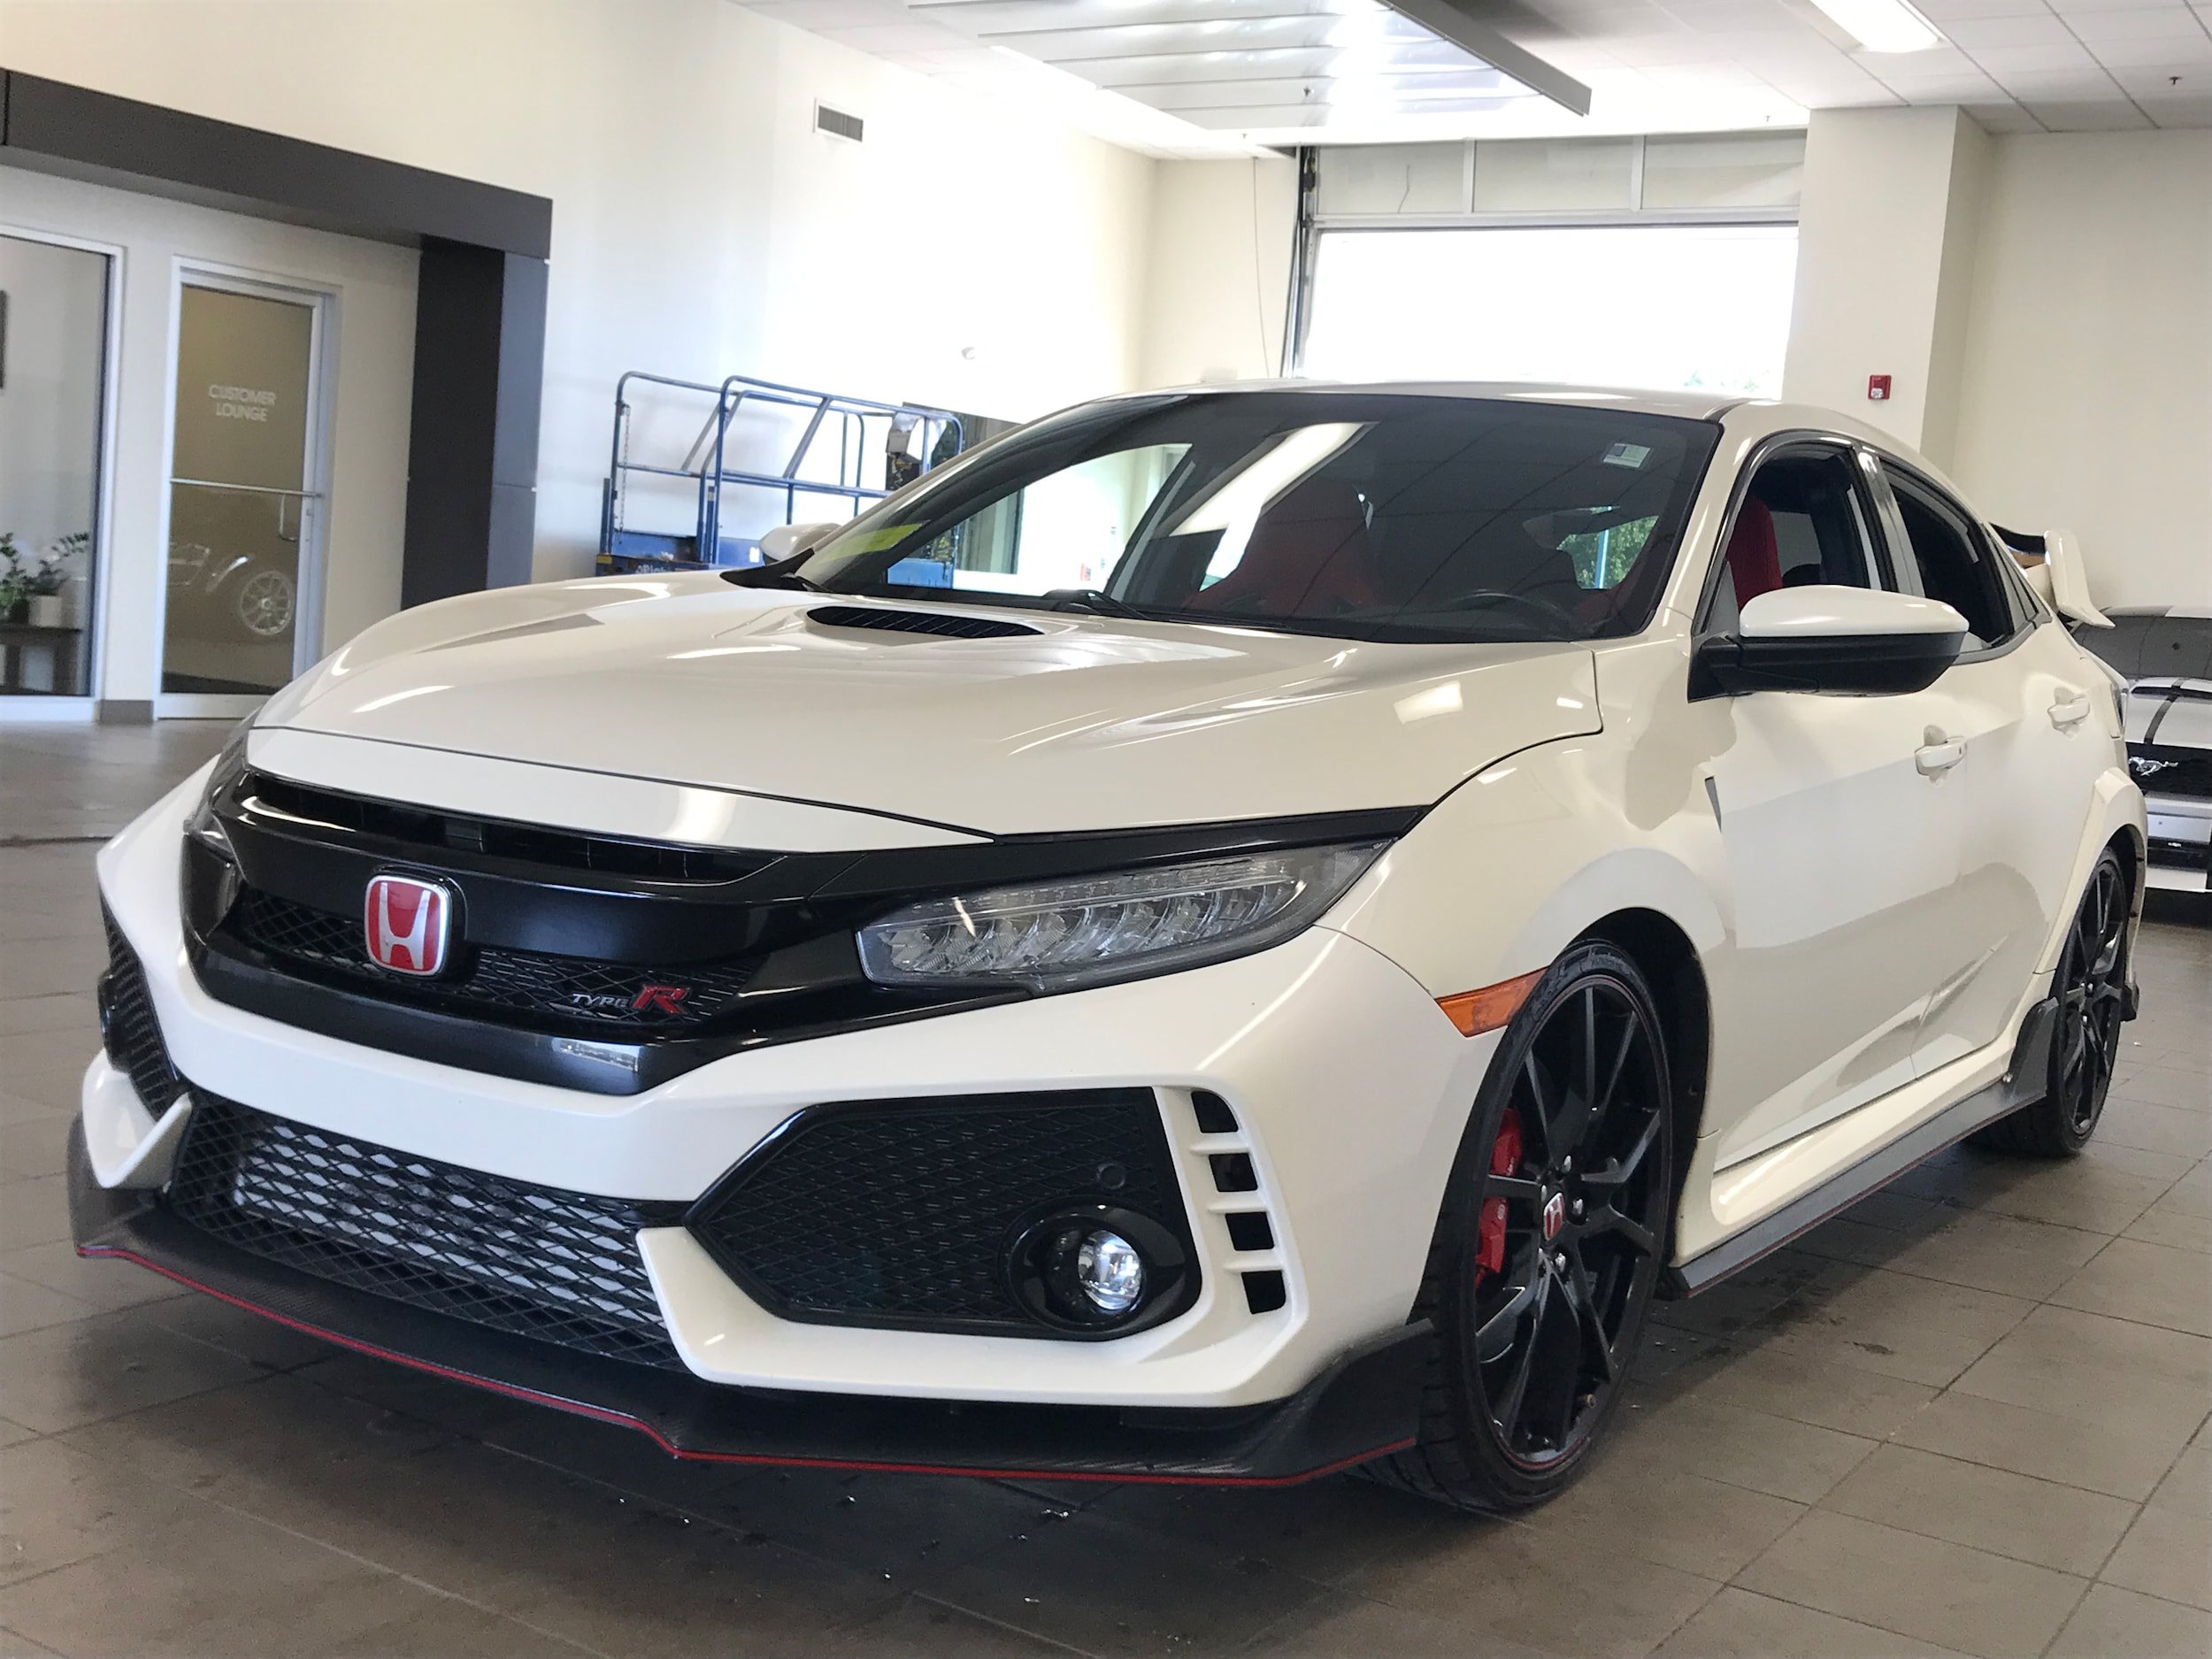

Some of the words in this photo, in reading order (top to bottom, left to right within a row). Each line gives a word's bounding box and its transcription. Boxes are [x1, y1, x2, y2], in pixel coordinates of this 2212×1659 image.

[209, 384, 276, 406] CUSTOMER
[216, 403, 268, 422] LOUNGE
[572, 993, 630, 1009] TYPE
[632, 984, 689, 1014] R
